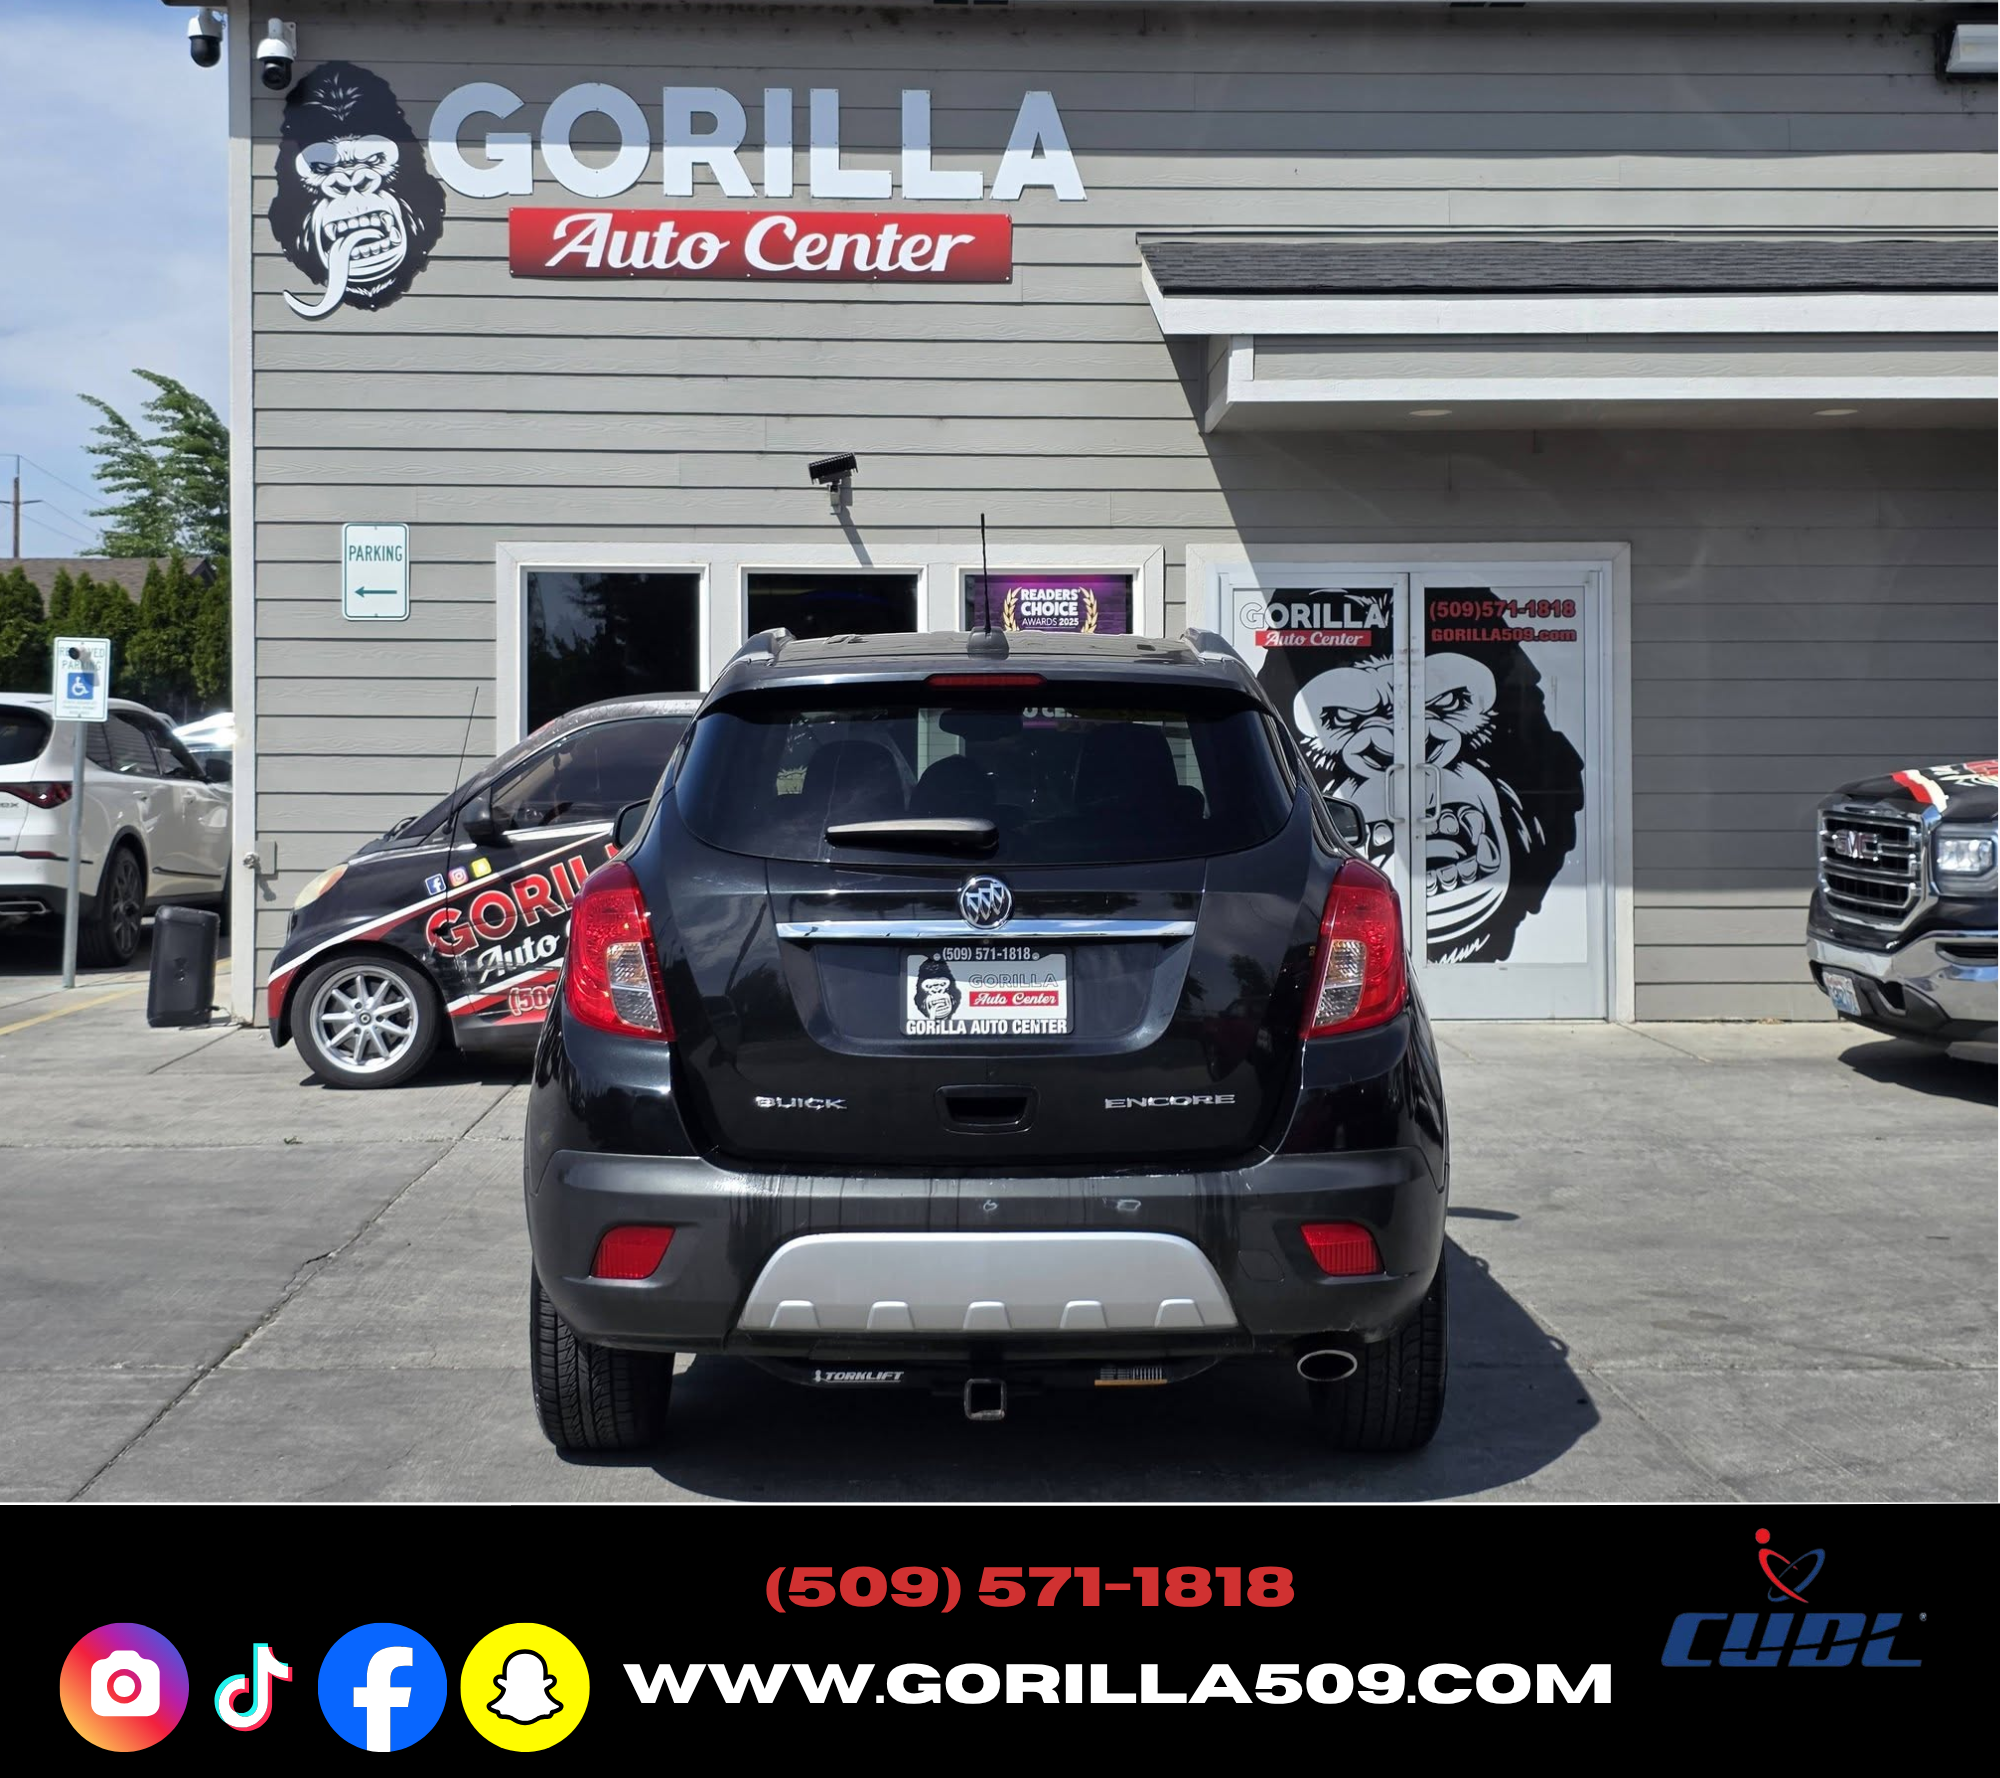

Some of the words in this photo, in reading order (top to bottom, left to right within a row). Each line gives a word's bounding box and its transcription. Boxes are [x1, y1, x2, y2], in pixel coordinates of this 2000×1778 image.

[428, 82, 1087, 201] GORILLA
[544, 211, 730, 273] Auto
[743, 214, 975, 274] Center
[348, 545, 403, 563] PARKING
[1021, 588, 1081, 601] READERS'
[1021, 602, 1079, 617] CHOICE
[1239, 602, 1388, 630] GORILLA
[1429, 599, 1577, 621] (509)571-1818
[1021, 618, 1058, 626] AWARDS
[1058, 618, 1080, 626] 2025
[1265, 631, 1306, 647] Auto
[1310, 631, 1364, 647] Center
[1430, 627, 1578, 643] GORILLA509.com
[1834, 829, 1879, 861] GMC
[477, 933, 560, 984] Auto
[942, 947, 972, 961] (509)
[975, 947, 1031, 960] 571-1818
[968, 973, 1059, 988] GORILLA
[974, 992, 1008, 1005] Auto
[1012, 992, 1057, 1005] Center
[970, 1019, 1008, 1035] AUTO
[1012, 1019, 1067, 1035] CENTER
[755, 1096, 847, 1110] BUICK
[1104, 1094, 1236, 1109] ENCORE
[825, 1371, 904, 1382] TORKLIFT
